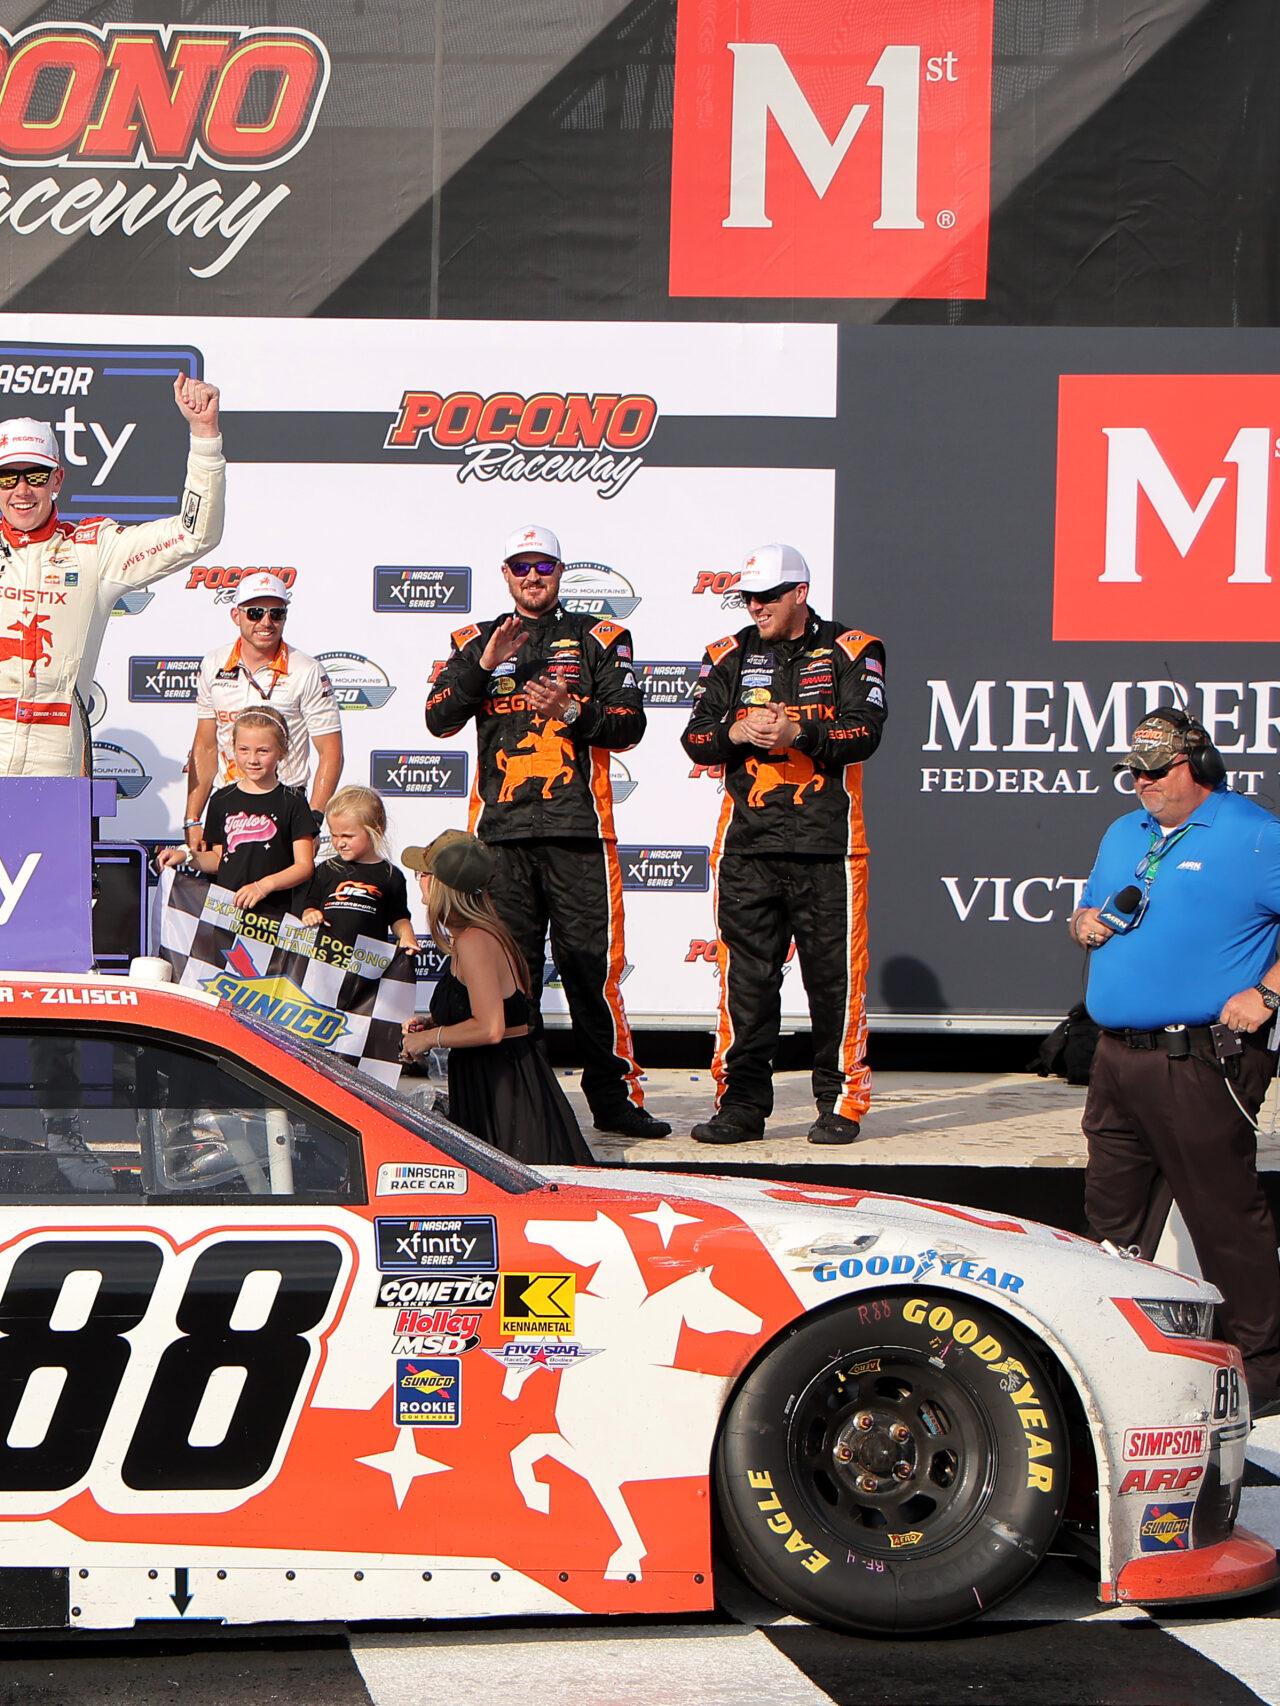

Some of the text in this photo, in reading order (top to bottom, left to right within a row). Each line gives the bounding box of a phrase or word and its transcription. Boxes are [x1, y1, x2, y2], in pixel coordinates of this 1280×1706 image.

[383, 390, 659, 451] POCONO
[457, 441, 645, 500] Raceway
[410, 571, 444, 580] NASCAR
[389, 581, 456, 604] xfinity
[408, 599, 436, 608] SERIES
[564, 600, 605, 613] 250
[165, 661, 199, 671] NASCAR
[651, 665, 686, 676] NASCAR
[145, 671, 199, 695] xfinit
[164, 688, 191, 698] SERIES
[650, 693, 679, 703] SERIES
[407, 755, 441, 765] NASCAR
[387, 765, 452, 791] xfinity
[920, 768, 1099, 795] FEDERAL
[405, 783, 432, 793] SERIES
[223, 810, 273, 835] Taylor
[650, 850, 683, 859] NASCAR
[628, 859, 694, 883] xfinity
[647, 878, 673, 887] SERIES
[203, 896, 392, 970] EXPLORE THE POCONO
[228, 921, 362, 975] MOUNTAINS 250
[40, 986, 139, 1006] ZILISCH
[217, 974, 346, 1042] SUNOCO
[407, 1168, 456, 1179] NASCAR
[390, 1180, 455, 1190] RACE CAR
[421, 1221, 462, 1231] NASCAR
[396, 1232, 477, 1260] xfinity
[420, 1255, 454, 1265] SERIES
[380, 1277, 496, 1303] COMETIC
[395, 1310, 482, 1340] Holley
[503, 1321, 572, 1332] KENNAMETAL
[392, 1335, 480, 1356] MSD
[504, 1345, 580, 1356] FIVE STAR
[402, 1376, 454, 1387] SUNOCO
[1213, 1367, 1240, 1420] 88
[400, 1401, 456, 1413] ROOKIE
[1128, 1430, 1203, 1458] SIMPSON
[1120, 1465, 1204, 1493] ARP
[747, 1469, 831, 1574] EAGLE
[1142, 1519, 1189, 1535] SUNOCO
[893, 1532, 917, 1546] AERO
